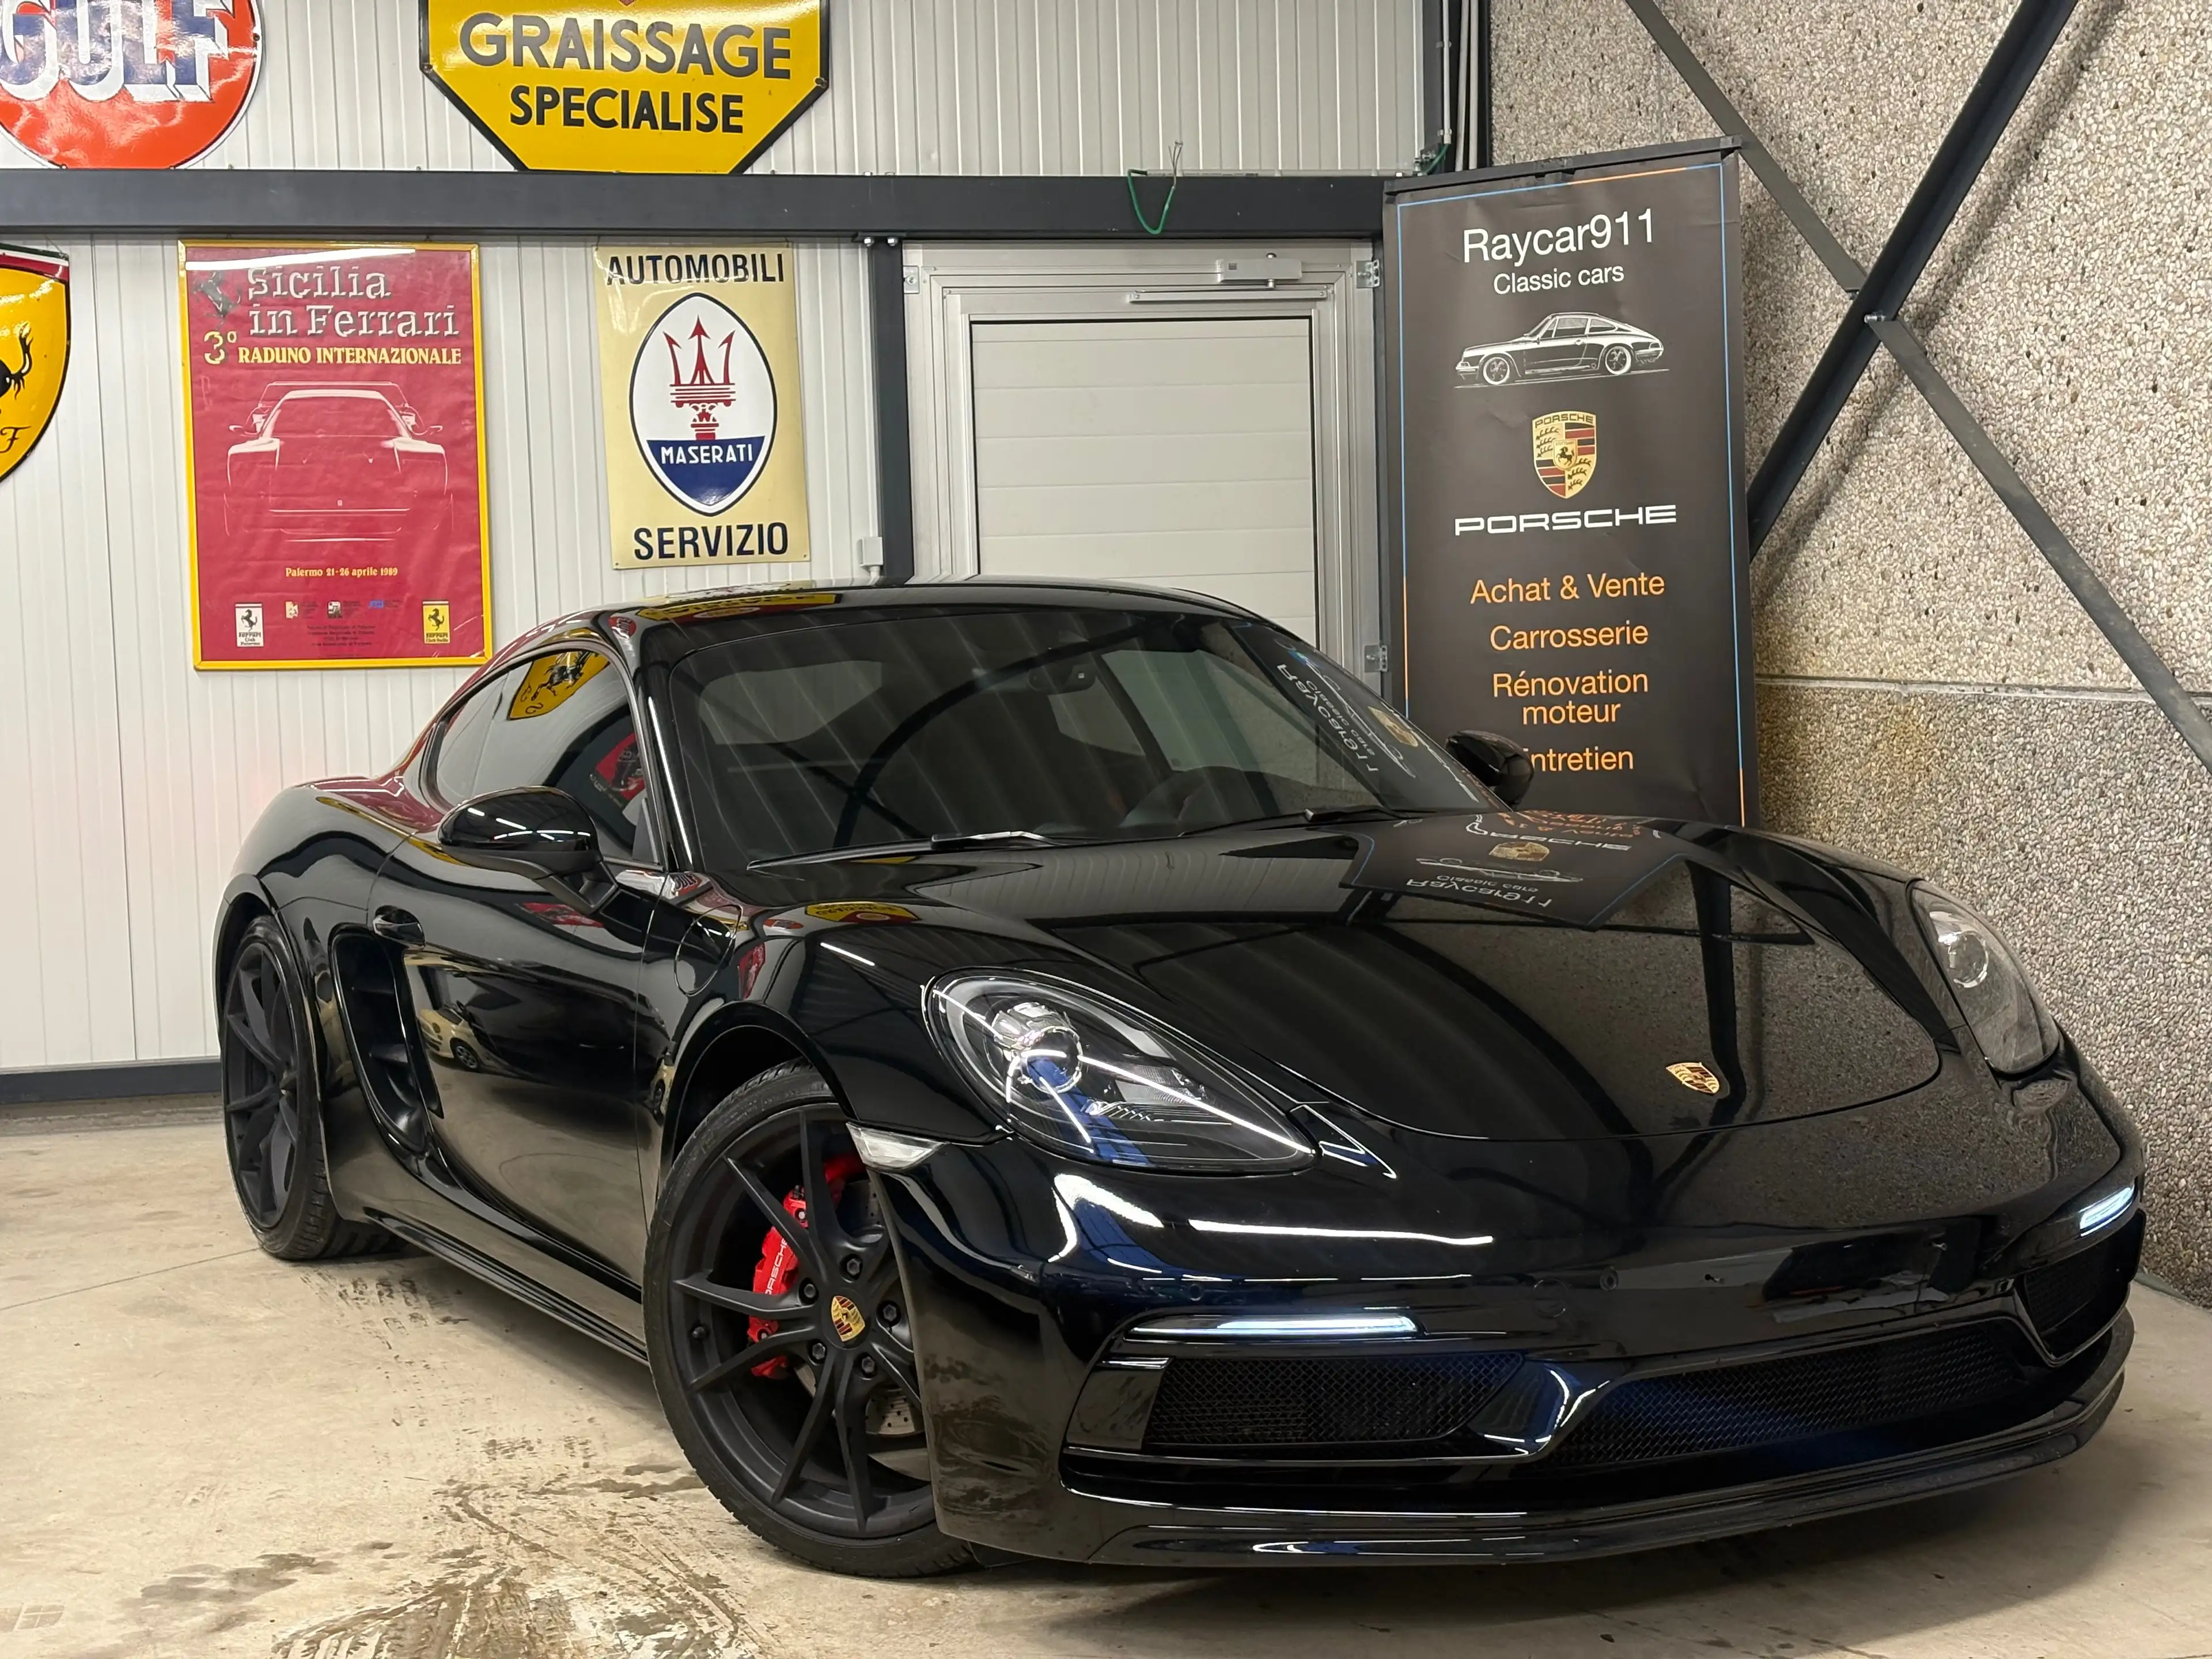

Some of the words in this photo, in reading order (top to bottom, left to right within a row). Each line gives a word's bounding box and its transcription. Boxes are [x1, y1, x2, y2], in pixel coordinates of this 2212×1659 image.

[0, 0, 235, 103] GULF
[460, 13, 791, 80] GRAISSAGE
[510, 85, 744, 134] SPECIALISE
[1463, 208, 1653, 267] Raycar911
[248, 266, 392, 300] Sicilia
[607, 253, 784, 285] AUTOMOBILI
[1494, 268, 1571, 294] Classic
[1578, 264, 1624, 286] cars
[249, 304, 298, 336] in
[306, 305, 459, 338] Ferrari
[238, 347, 311, 364] RADUNO
[316, 347, 461, 365] INTERNAZIONALE
[1535, 413, 1593, 429] PORSCHE
[661, 444, 753, 464] MASERATI
[1455, 505, 1676, 536] PORSCHE
[634, 522, 788, 560] SERVIZIO
[285, 567, 323, 577] Palermo
[351, 566, 378, 578] aprile
[1470, 578, 1551, 604] Achat
[1560, 575, 1579, 600] &
[1587, 572, 1665, 597] Vente
[1490, 620, 1649, 650] Carrosserie
[1493, 669, 1648, 697] Rénovation
[1522, 700, 1620, 725] moteur
[1522, 746, 1634, 771] ntretien
